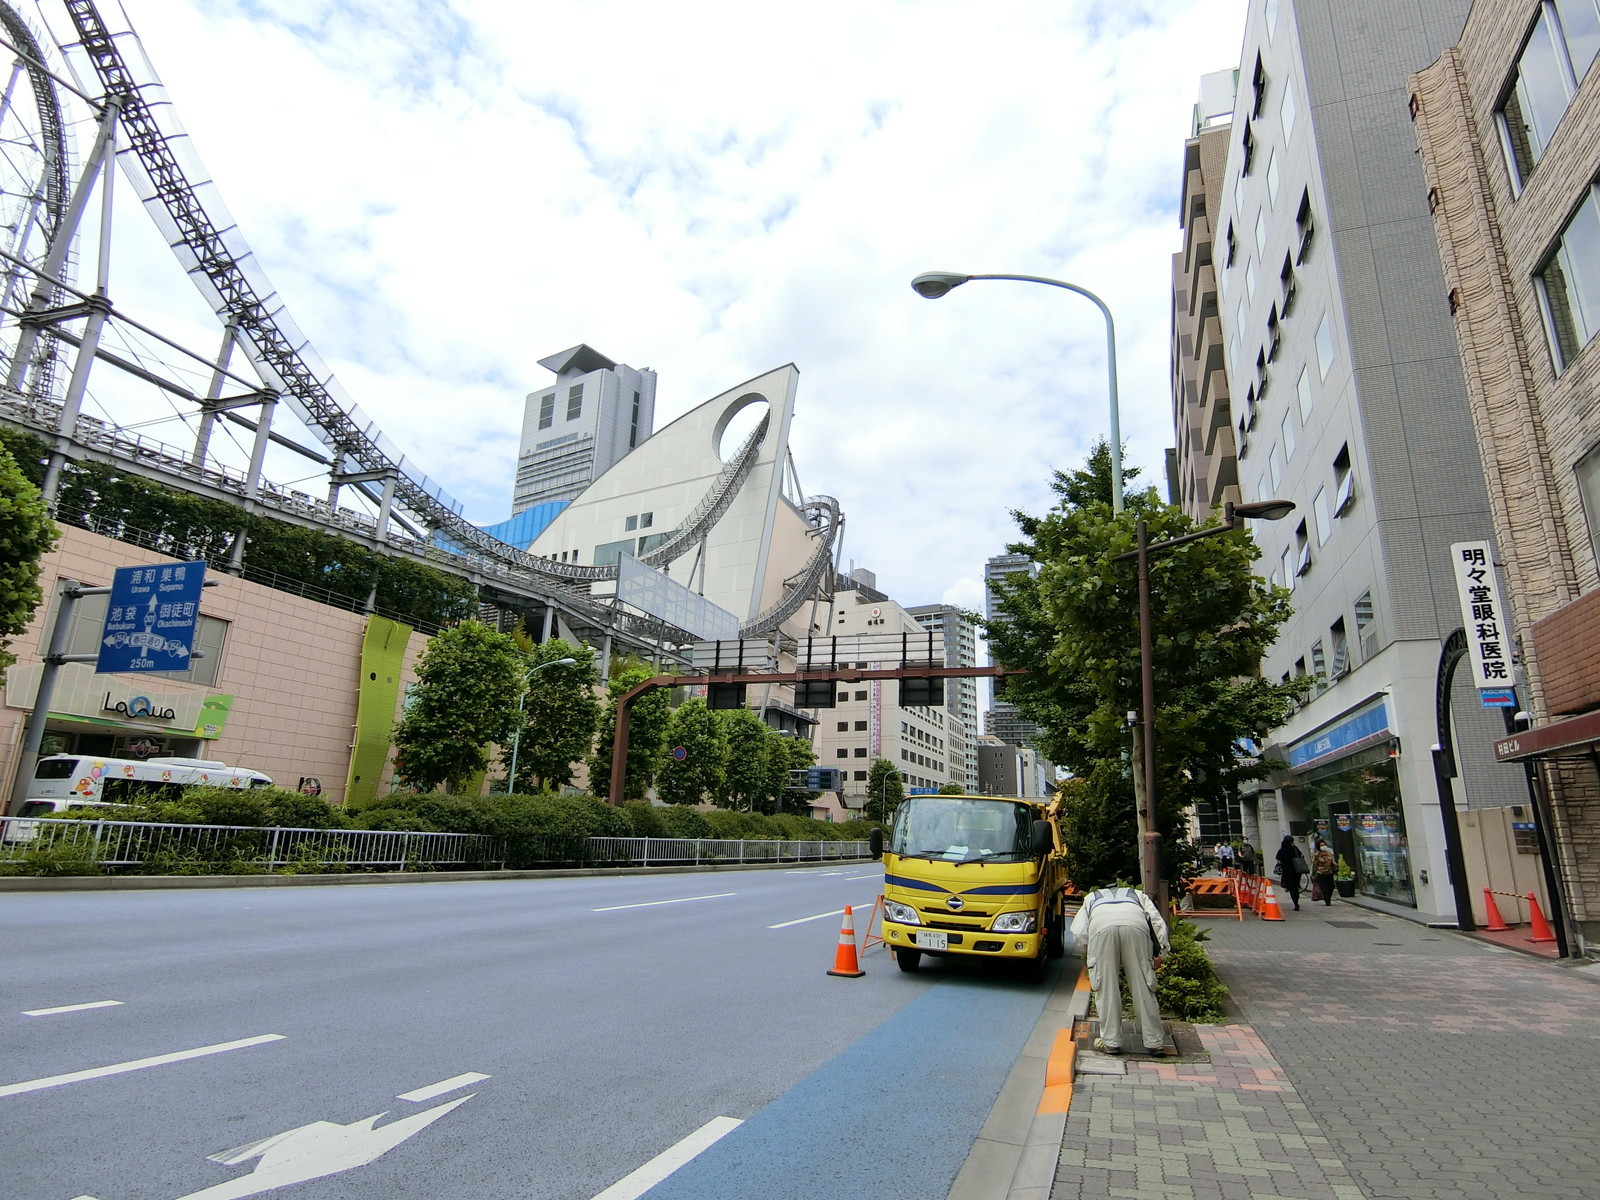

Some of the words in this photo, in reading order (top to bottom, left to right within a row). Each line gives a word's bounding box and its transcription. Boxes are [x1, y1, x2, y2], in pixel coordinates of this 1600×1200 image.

[131, 569, 156, 584] 浦和
[161, 567, 186, 582] 巣鴨
[159, 584, 184, 592] Sugamo
[111, 606, 137, 621] 池袋
[160, 602, 195, 618] 御徒町
[1462, 549, 1508, 679] 明々堂眼科医院
[157, 619, 193, 628] Okachimachi
[133, 634, 162, 645] 春日通り
[130, 659, 154, 668] 250m
[103, 692, 175, 719] LaQua
